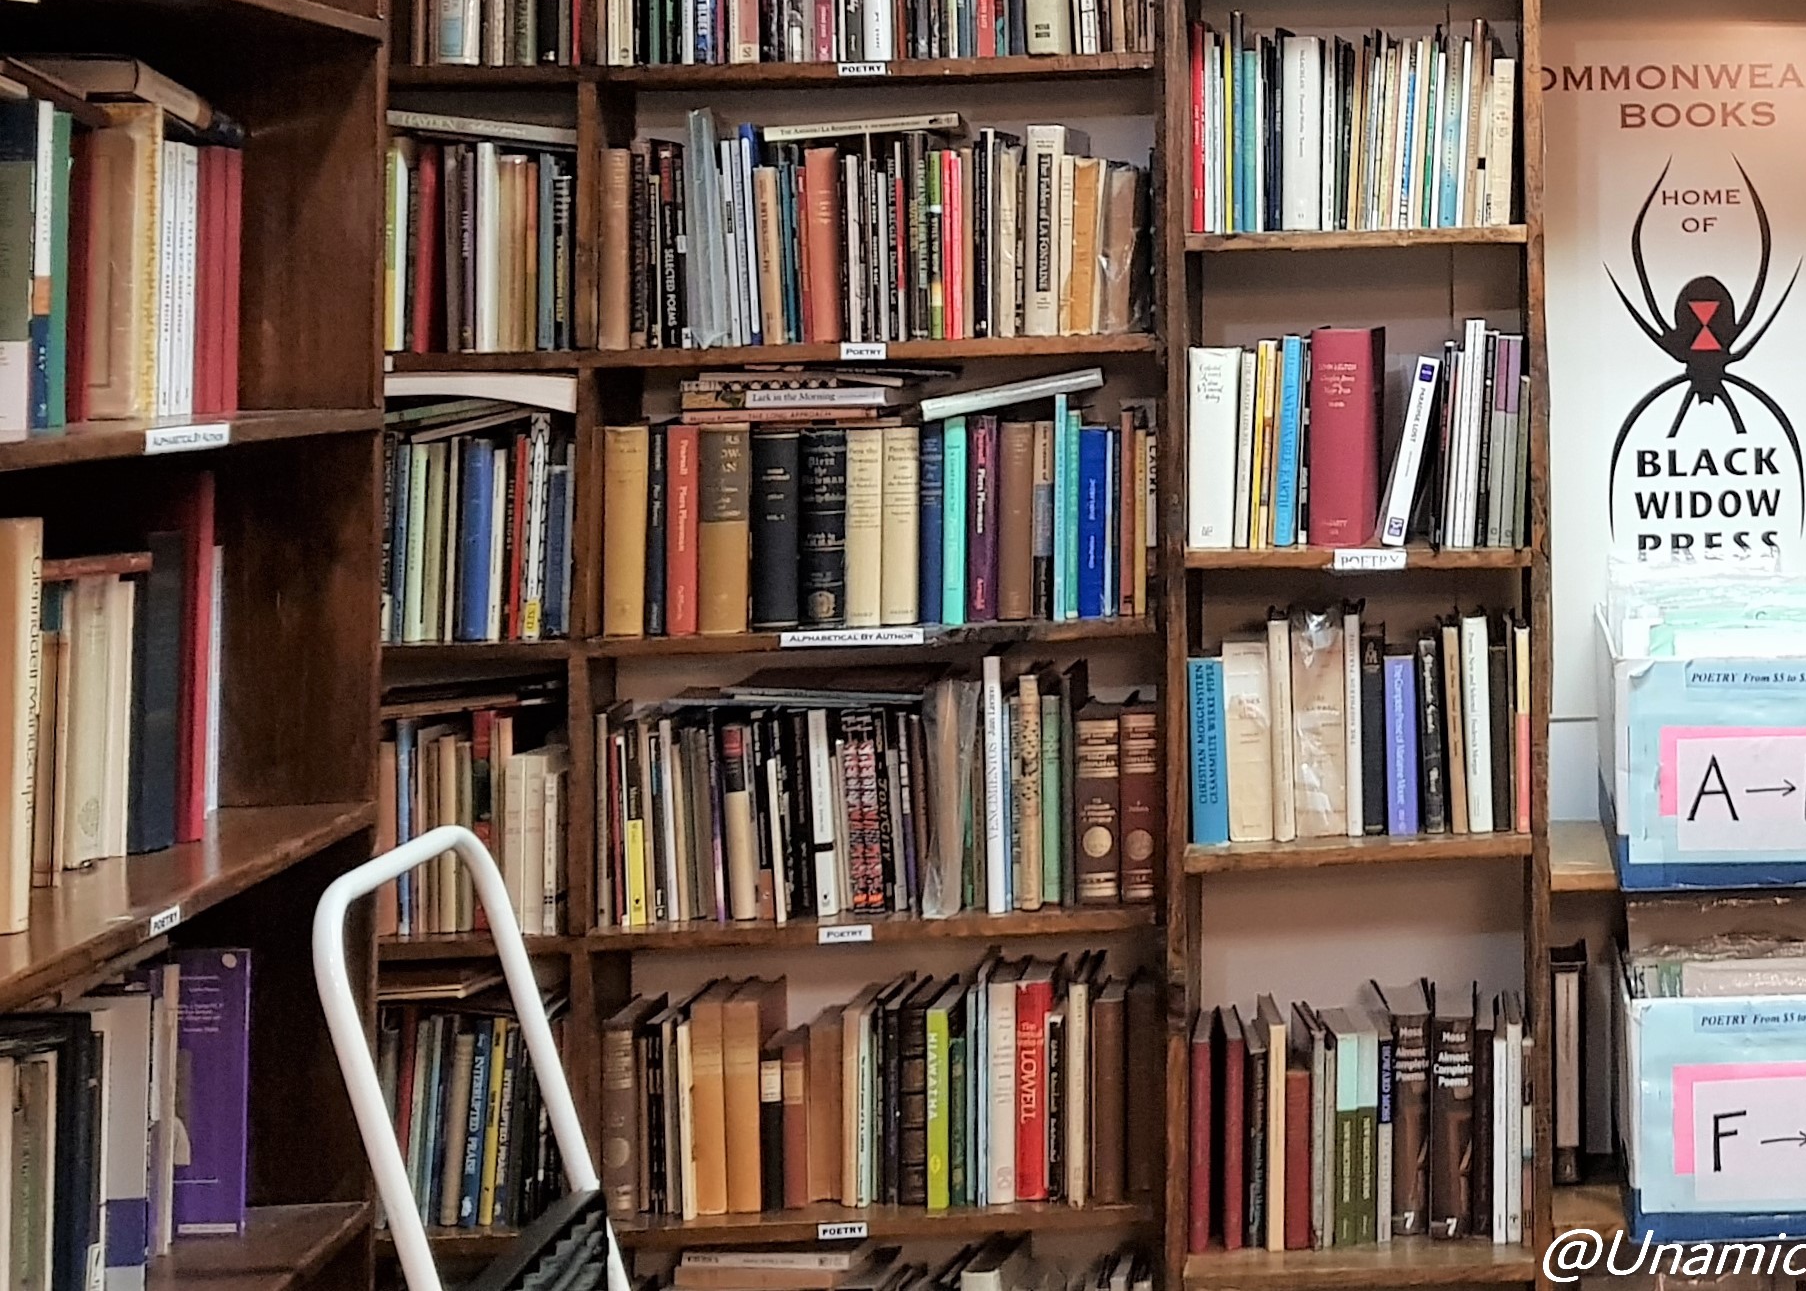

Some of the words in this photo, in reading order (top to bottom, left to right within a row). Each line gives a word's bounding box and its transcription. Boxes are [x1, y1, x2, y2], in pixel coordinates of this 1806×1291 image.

[841, 64, 882, 73] POETRY
[1619, 101, 1777, 129] BOOKS
[1661, 189, 1742, 206] HOME
[1681, 216, 1718, 234] OF
[664, 248, 676, 292] SELECTED
[666, 293, 677, 327] POEMS
[846, 348, 881, 356] POETRY
[1410, 424, 1420, 443] LOST
[1635, 447, 1781, 478] BLACK
[1634, 488, 1781, 520] WIDOW
[789, 634, 858, 643] ALPHABETICAL
[860, 633, 873, 642] BY
[875, 632, 914, 642] AUTHOR
[1690, 671, 1739, 683] POETRY
[1742, 671, 1770, 683] From
[1772, 671, 1785, 683] $5
[1787, 671, 1798, 682] to
[1686, 754, 1740, 822] A
[152, 910, 180, 933] POETRY
[1700, 1013, 1748, 1026] POETRY
[1752, 1012, 1780, 1025] From
[1782, 1011, 1796, 1024] $5
[1441, 1032, 1467, 1043] Moss
[1438, 1052, 1470, 1063] Almost
[927, 1032, 938, 1121] HIAWATHA
[1433, 1064, 1473, 1076] Complete
[1019, 1049, 1037, 1125] LOWELL
[1438, 1076, 1470, 1087] Poems
[1712, 1109, 1747, 1173] F
[821, 1225, 864, 1236] POETRY
